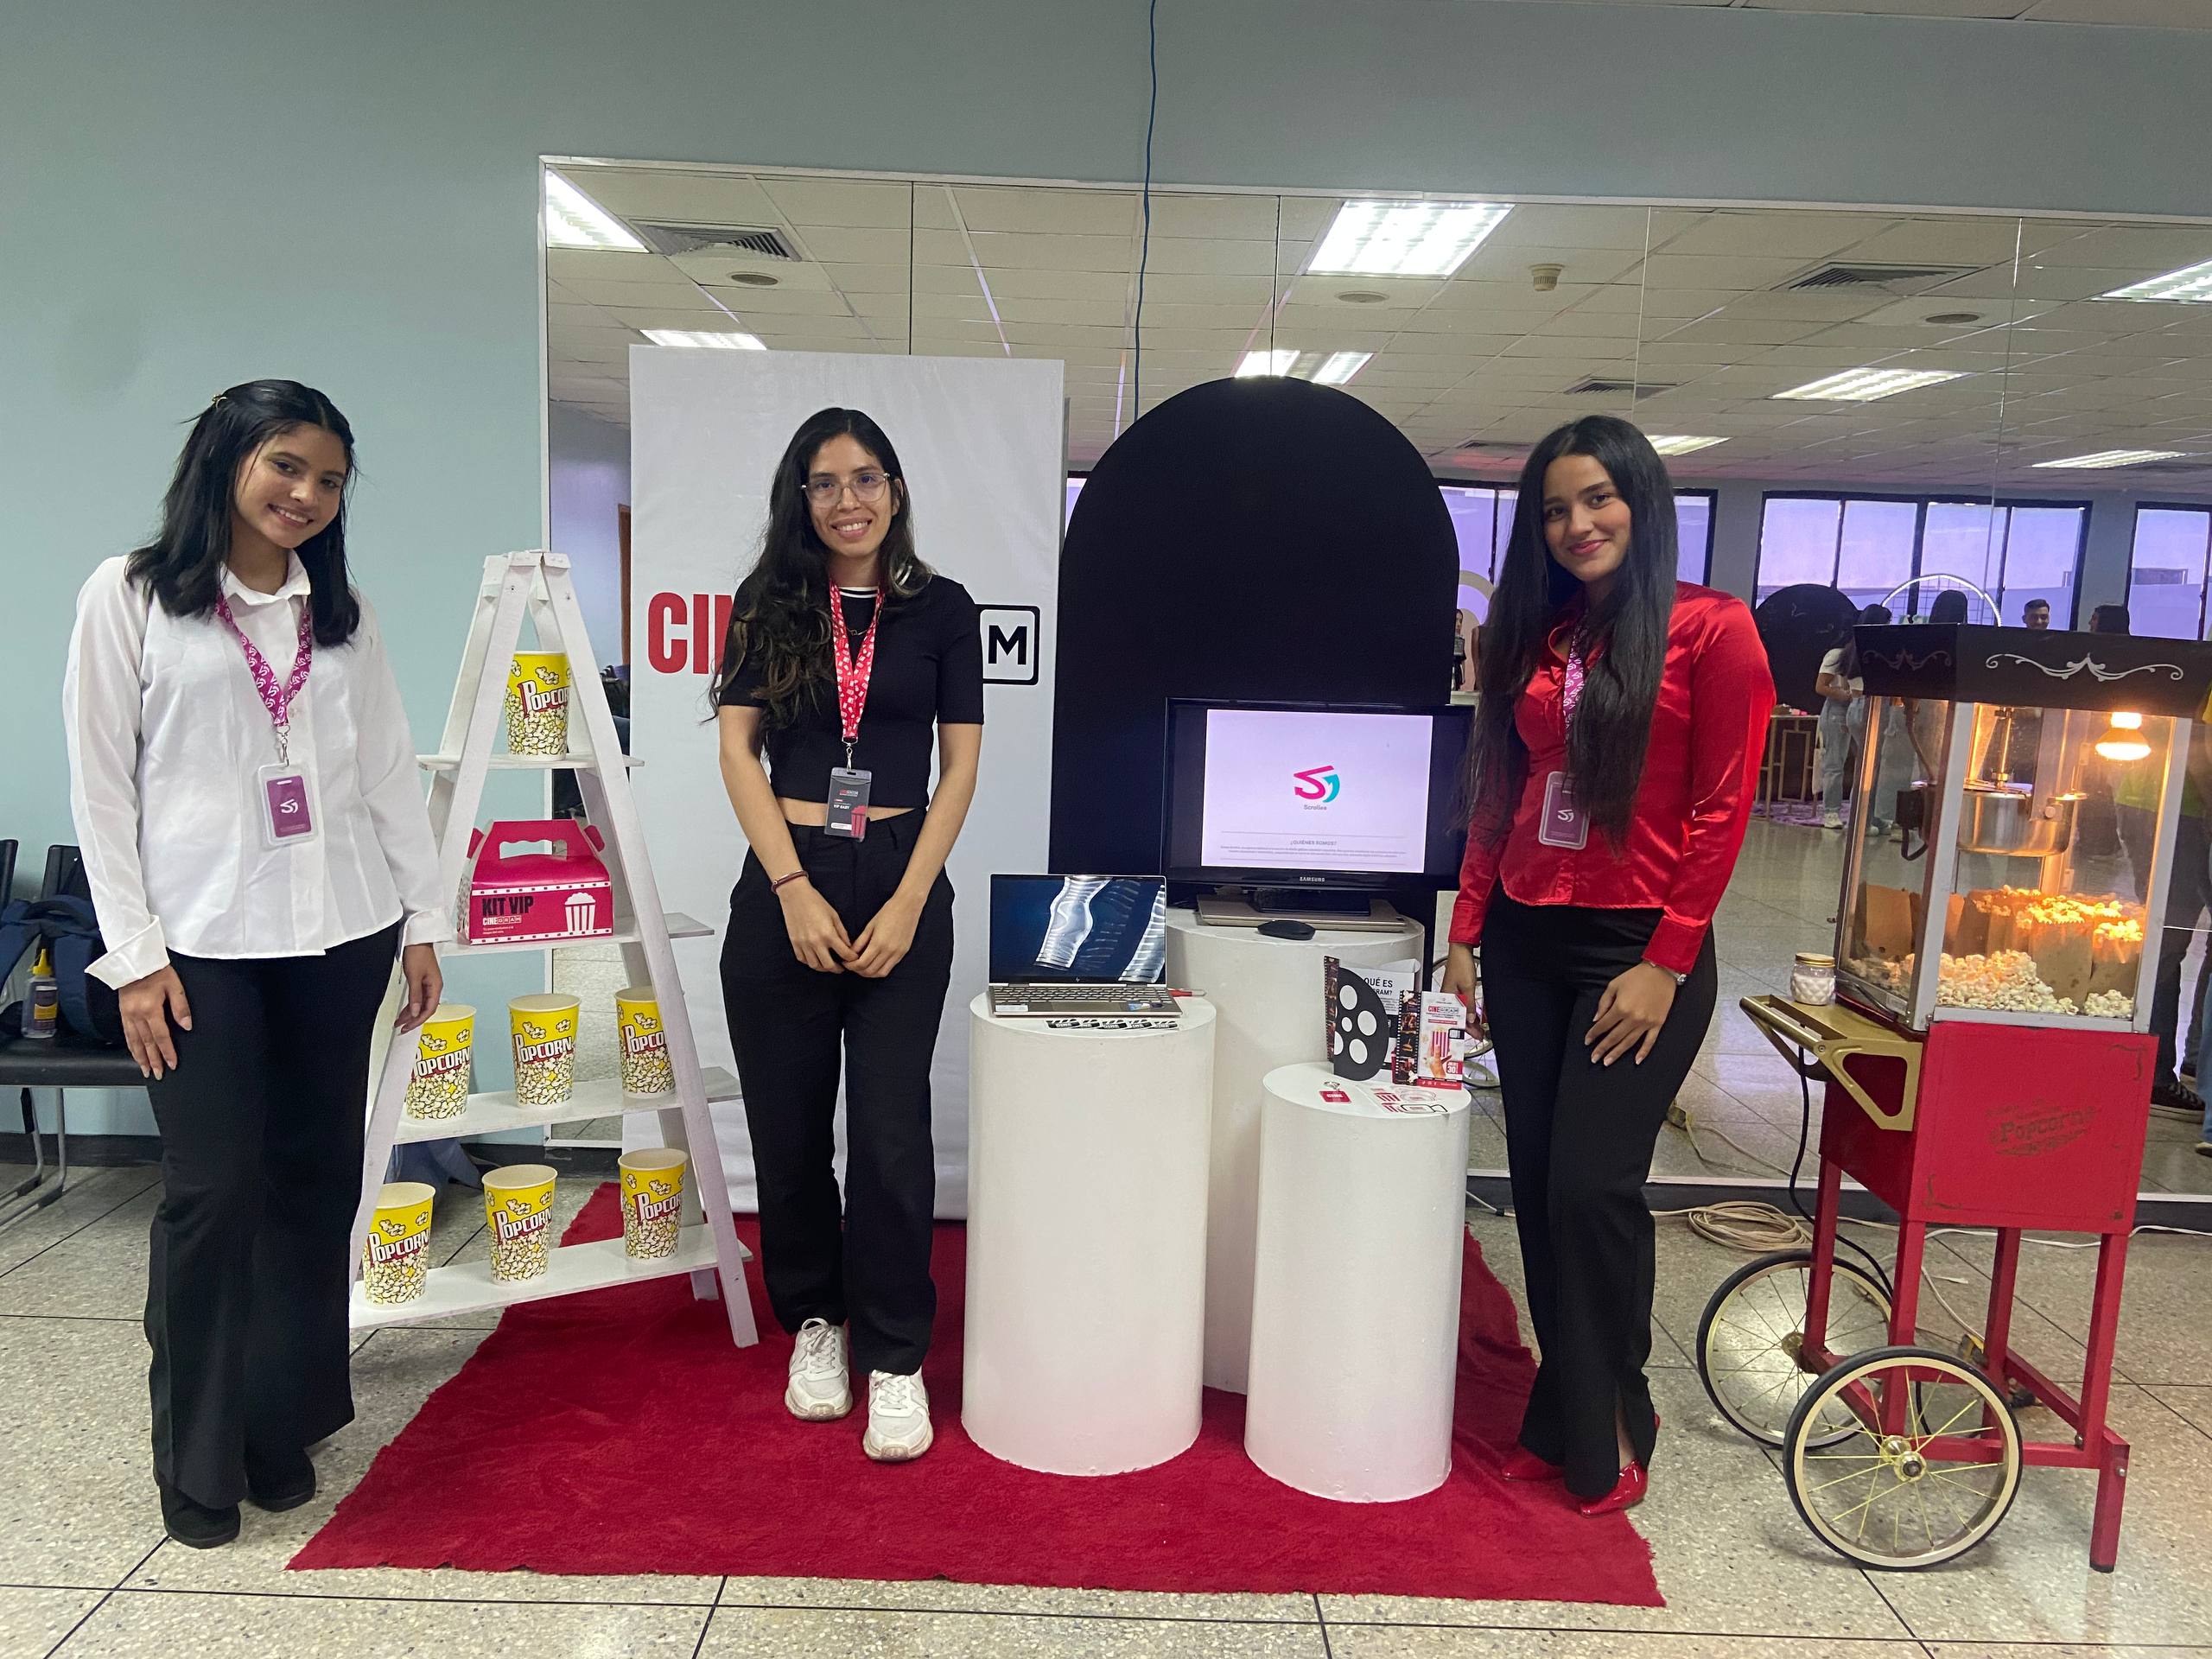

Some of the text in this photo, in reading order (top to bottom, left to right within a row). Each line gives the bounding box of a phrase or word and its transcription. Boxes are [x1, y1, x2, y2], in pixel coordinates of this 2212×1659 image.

[481, 895, 534, 916] KIT VIP
[1382, 979, 1393, 988] ES
[513, 1033, 574, 1068] POPCORN
[622, 1025, 666, 1058] POPCO
[493, 1205, 553, 1245] POPCORN
[368, 1228, 430, 1267] POPCORN
